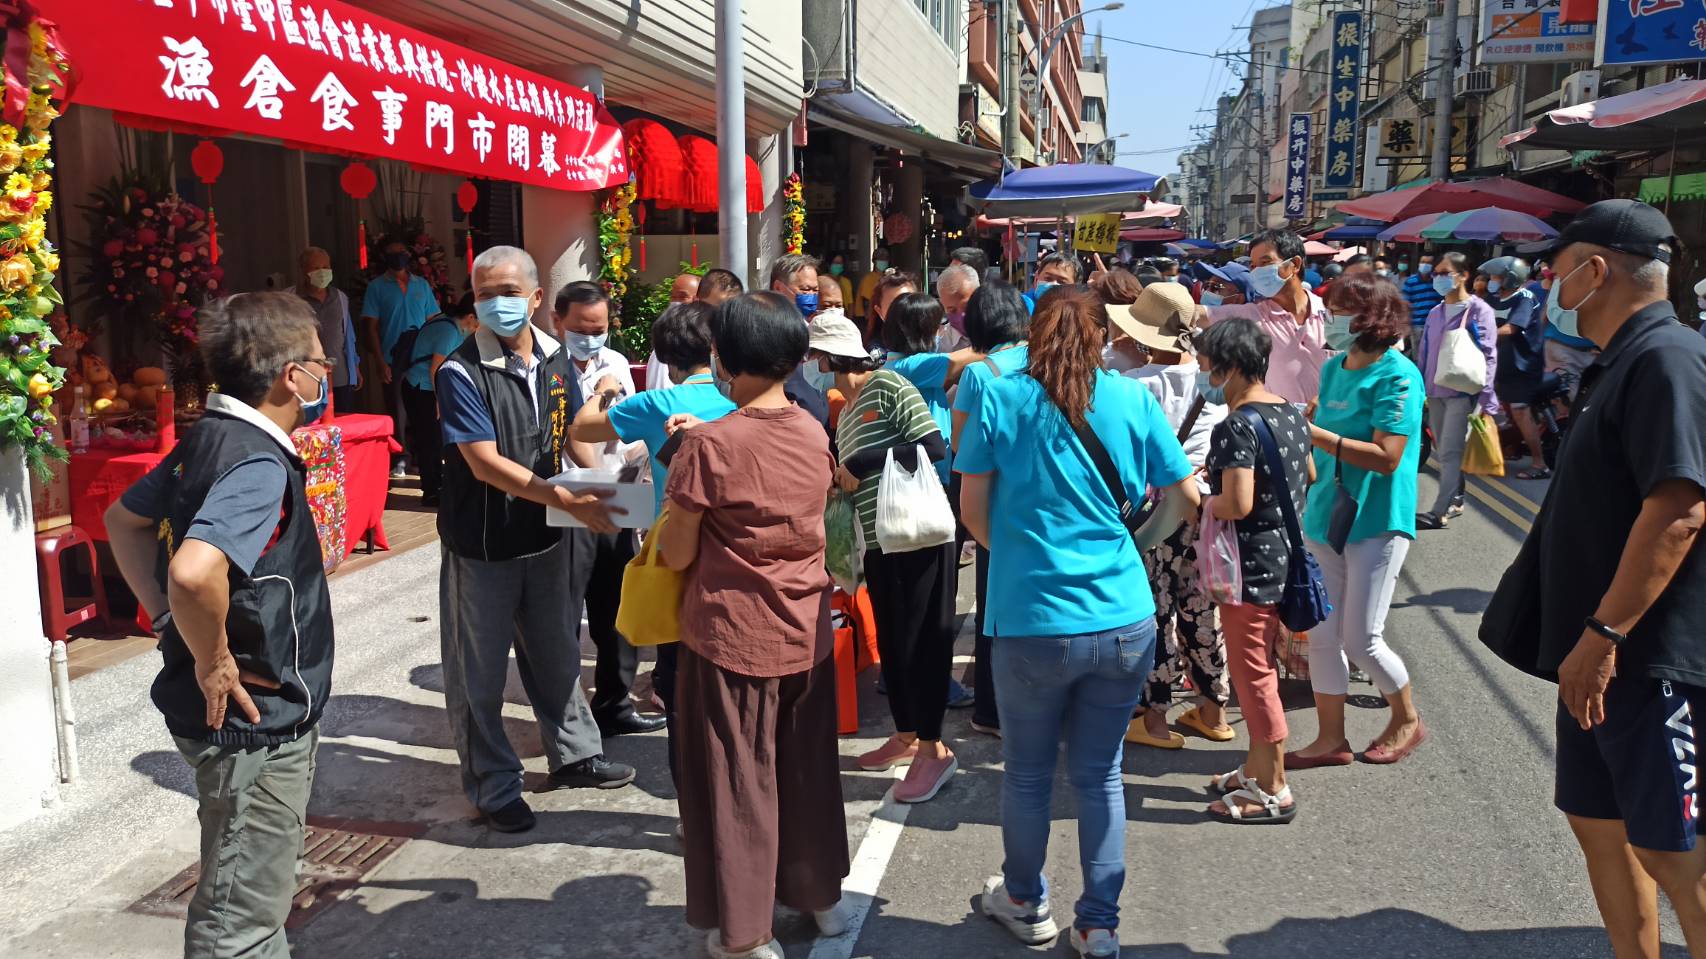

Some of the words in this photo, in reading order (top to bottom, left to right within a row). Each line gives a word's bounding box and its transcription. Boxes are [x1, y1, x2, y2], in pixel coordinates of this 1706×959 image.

[158, 36, 561, 177] 漁倉食事門市開幕
